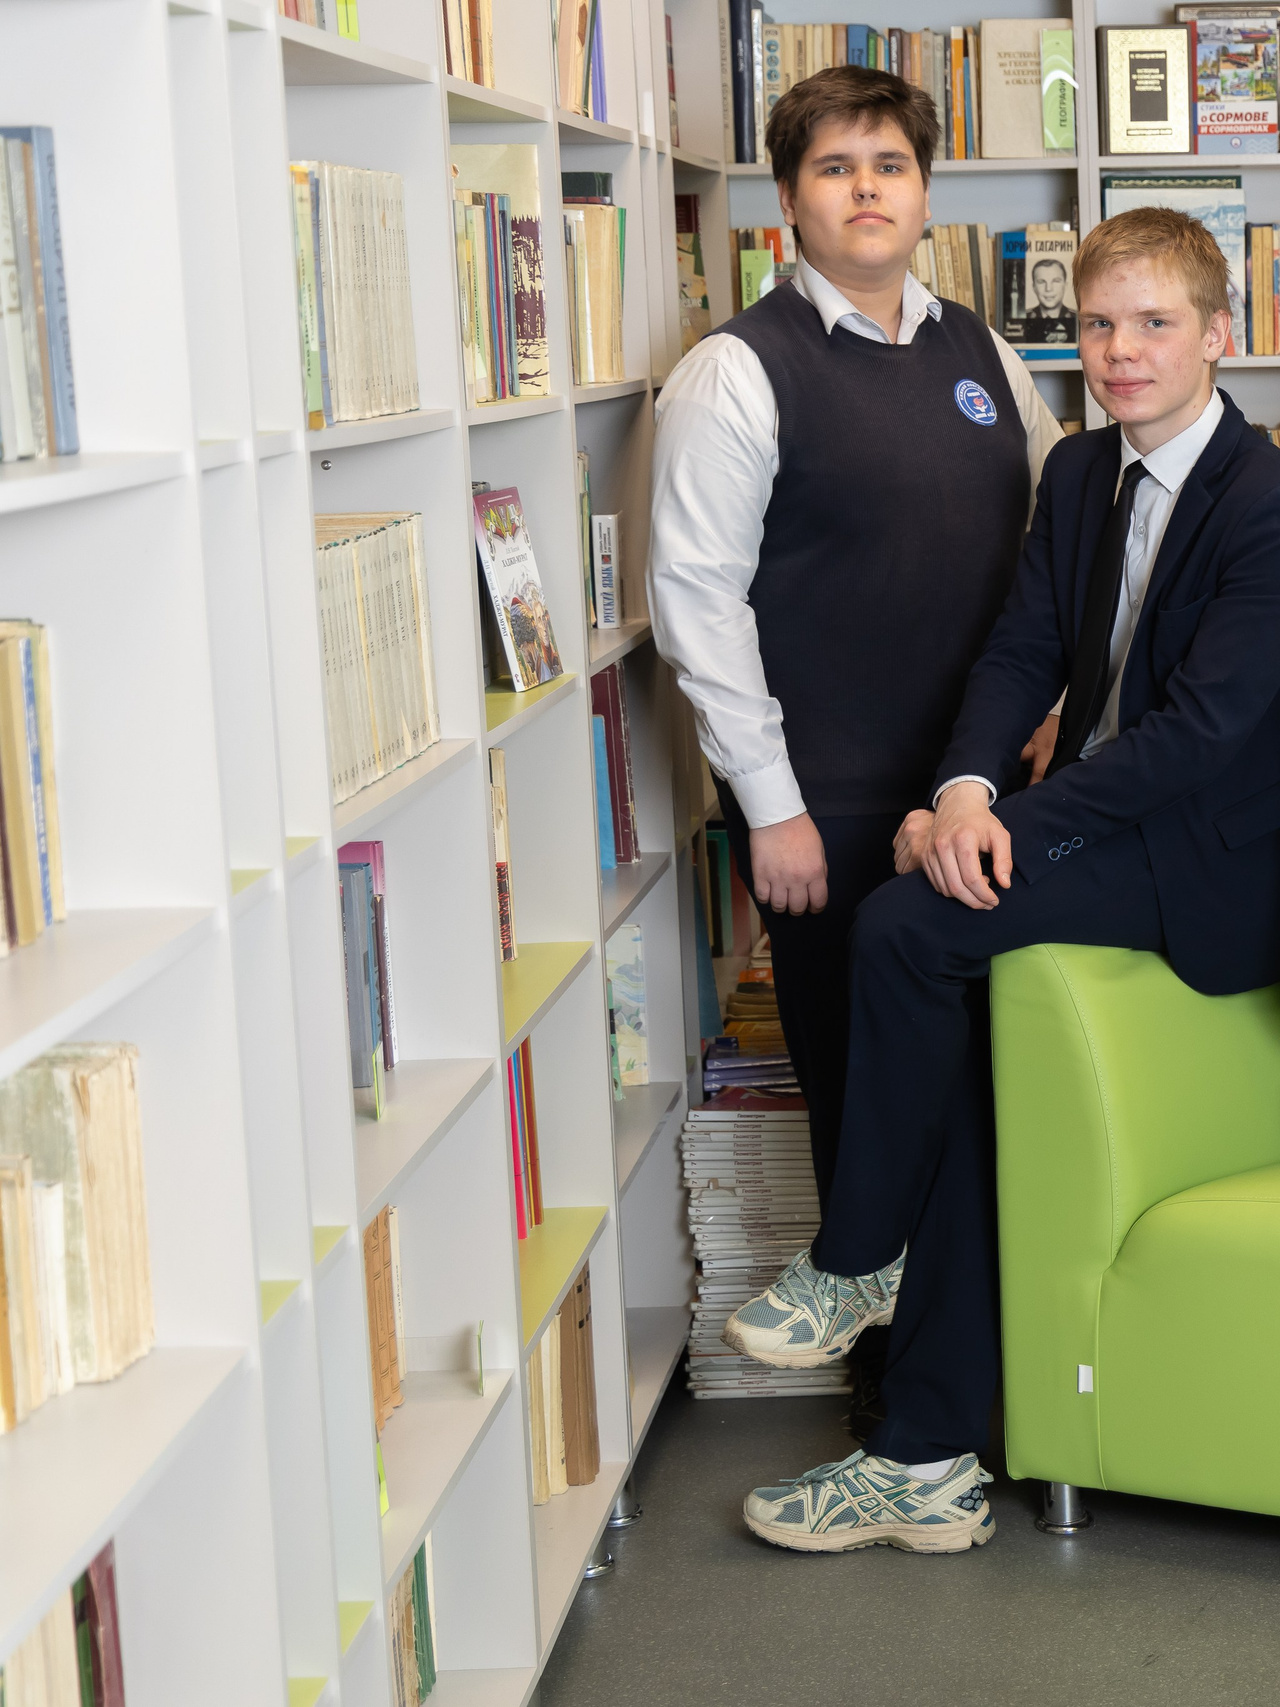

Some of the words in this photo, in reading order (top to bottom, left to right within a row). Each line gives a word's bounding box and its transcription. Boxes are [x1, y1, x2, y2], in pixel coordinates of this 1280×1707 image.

[997, 51, 1041, 60] ХРЕСТОМА
[1058, 78, 1068, 128] ГЕОГРАФИ
[1209, 112, 1268, 122] СОРМОВЕ
[1209, 125, 1269, 133] СОРМОВИЧАХ
[1005, 240, 1032, 253] ЮРИЙ
[1035, 240, 1073, 252] ГАГАРИН
[745, 271, 753, 302] ЛЕСНОЕ
[501, 552, 528, 568] ХАДЖИ-МУРАТ
[601, 566, 614, 588] ЯЗЫК
[492, 593, 509, 638] ХАДЖИ-МУРАТ
[600, 591, 615, 623] РУССКИЙ
